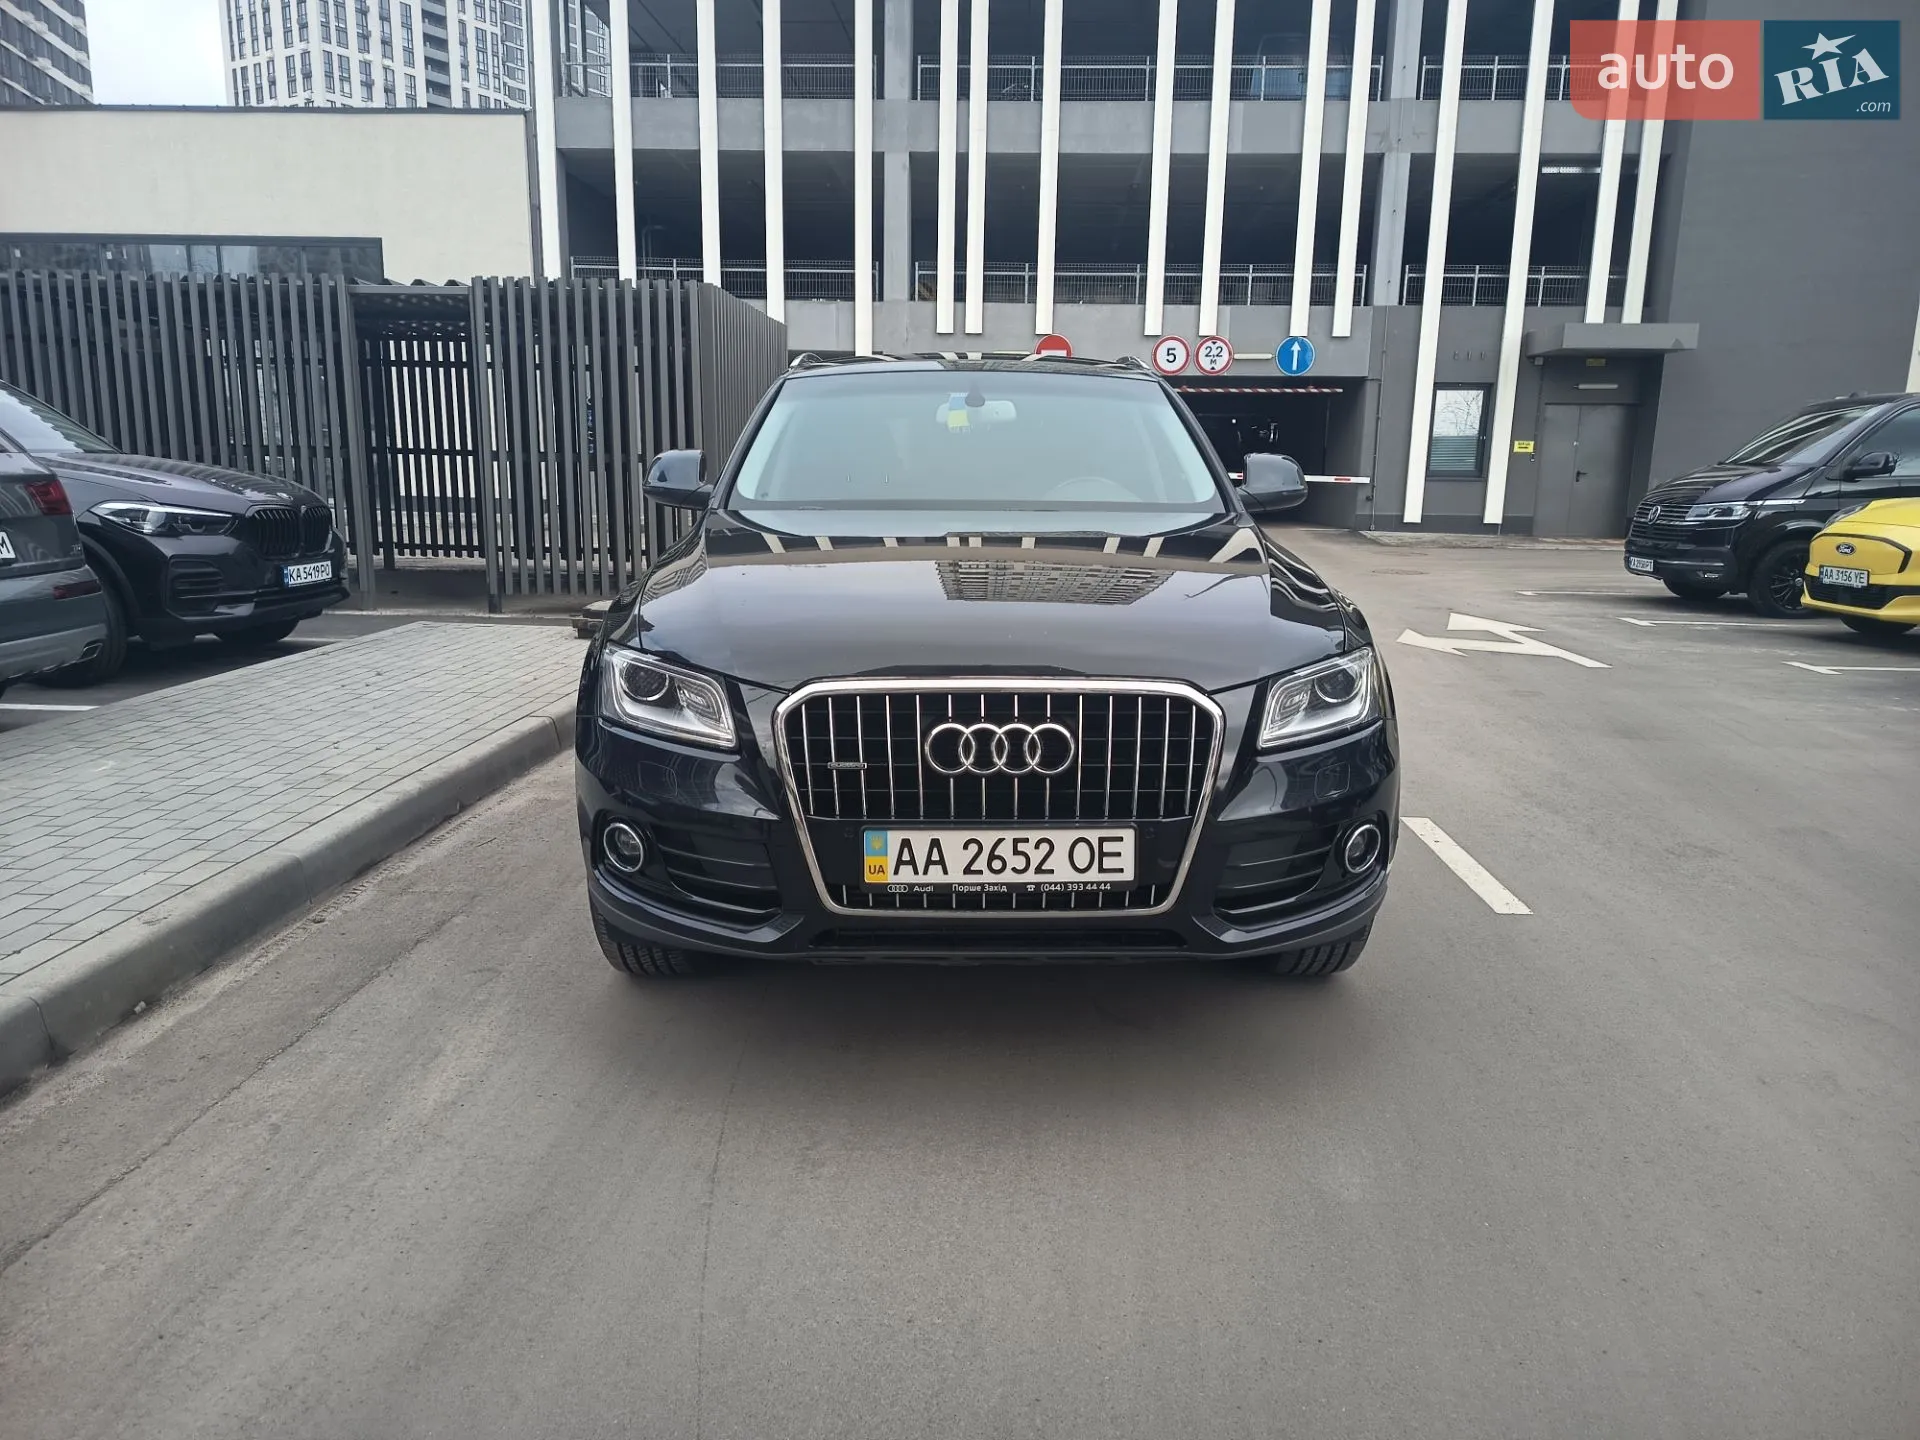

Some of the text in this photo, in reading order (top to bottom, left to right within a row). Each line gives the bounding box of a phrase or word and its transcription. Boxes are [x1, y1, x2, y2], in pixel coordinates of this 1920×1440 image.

[1165, 347, 1177, 364] 5
[1204, 345, 1223, 358] 2,2
[289, 567, 303, 582] KA
[303, 564, 320, 580] 5419
[1824, 568, 1865, 584] AA 3156 YE
[893, 836, 1125, 876] AA 2652 OE
[868, 864, 886, 875] UA
[913, 882, 1111, 893] Audi Порше Захід (044) 393 44 44
